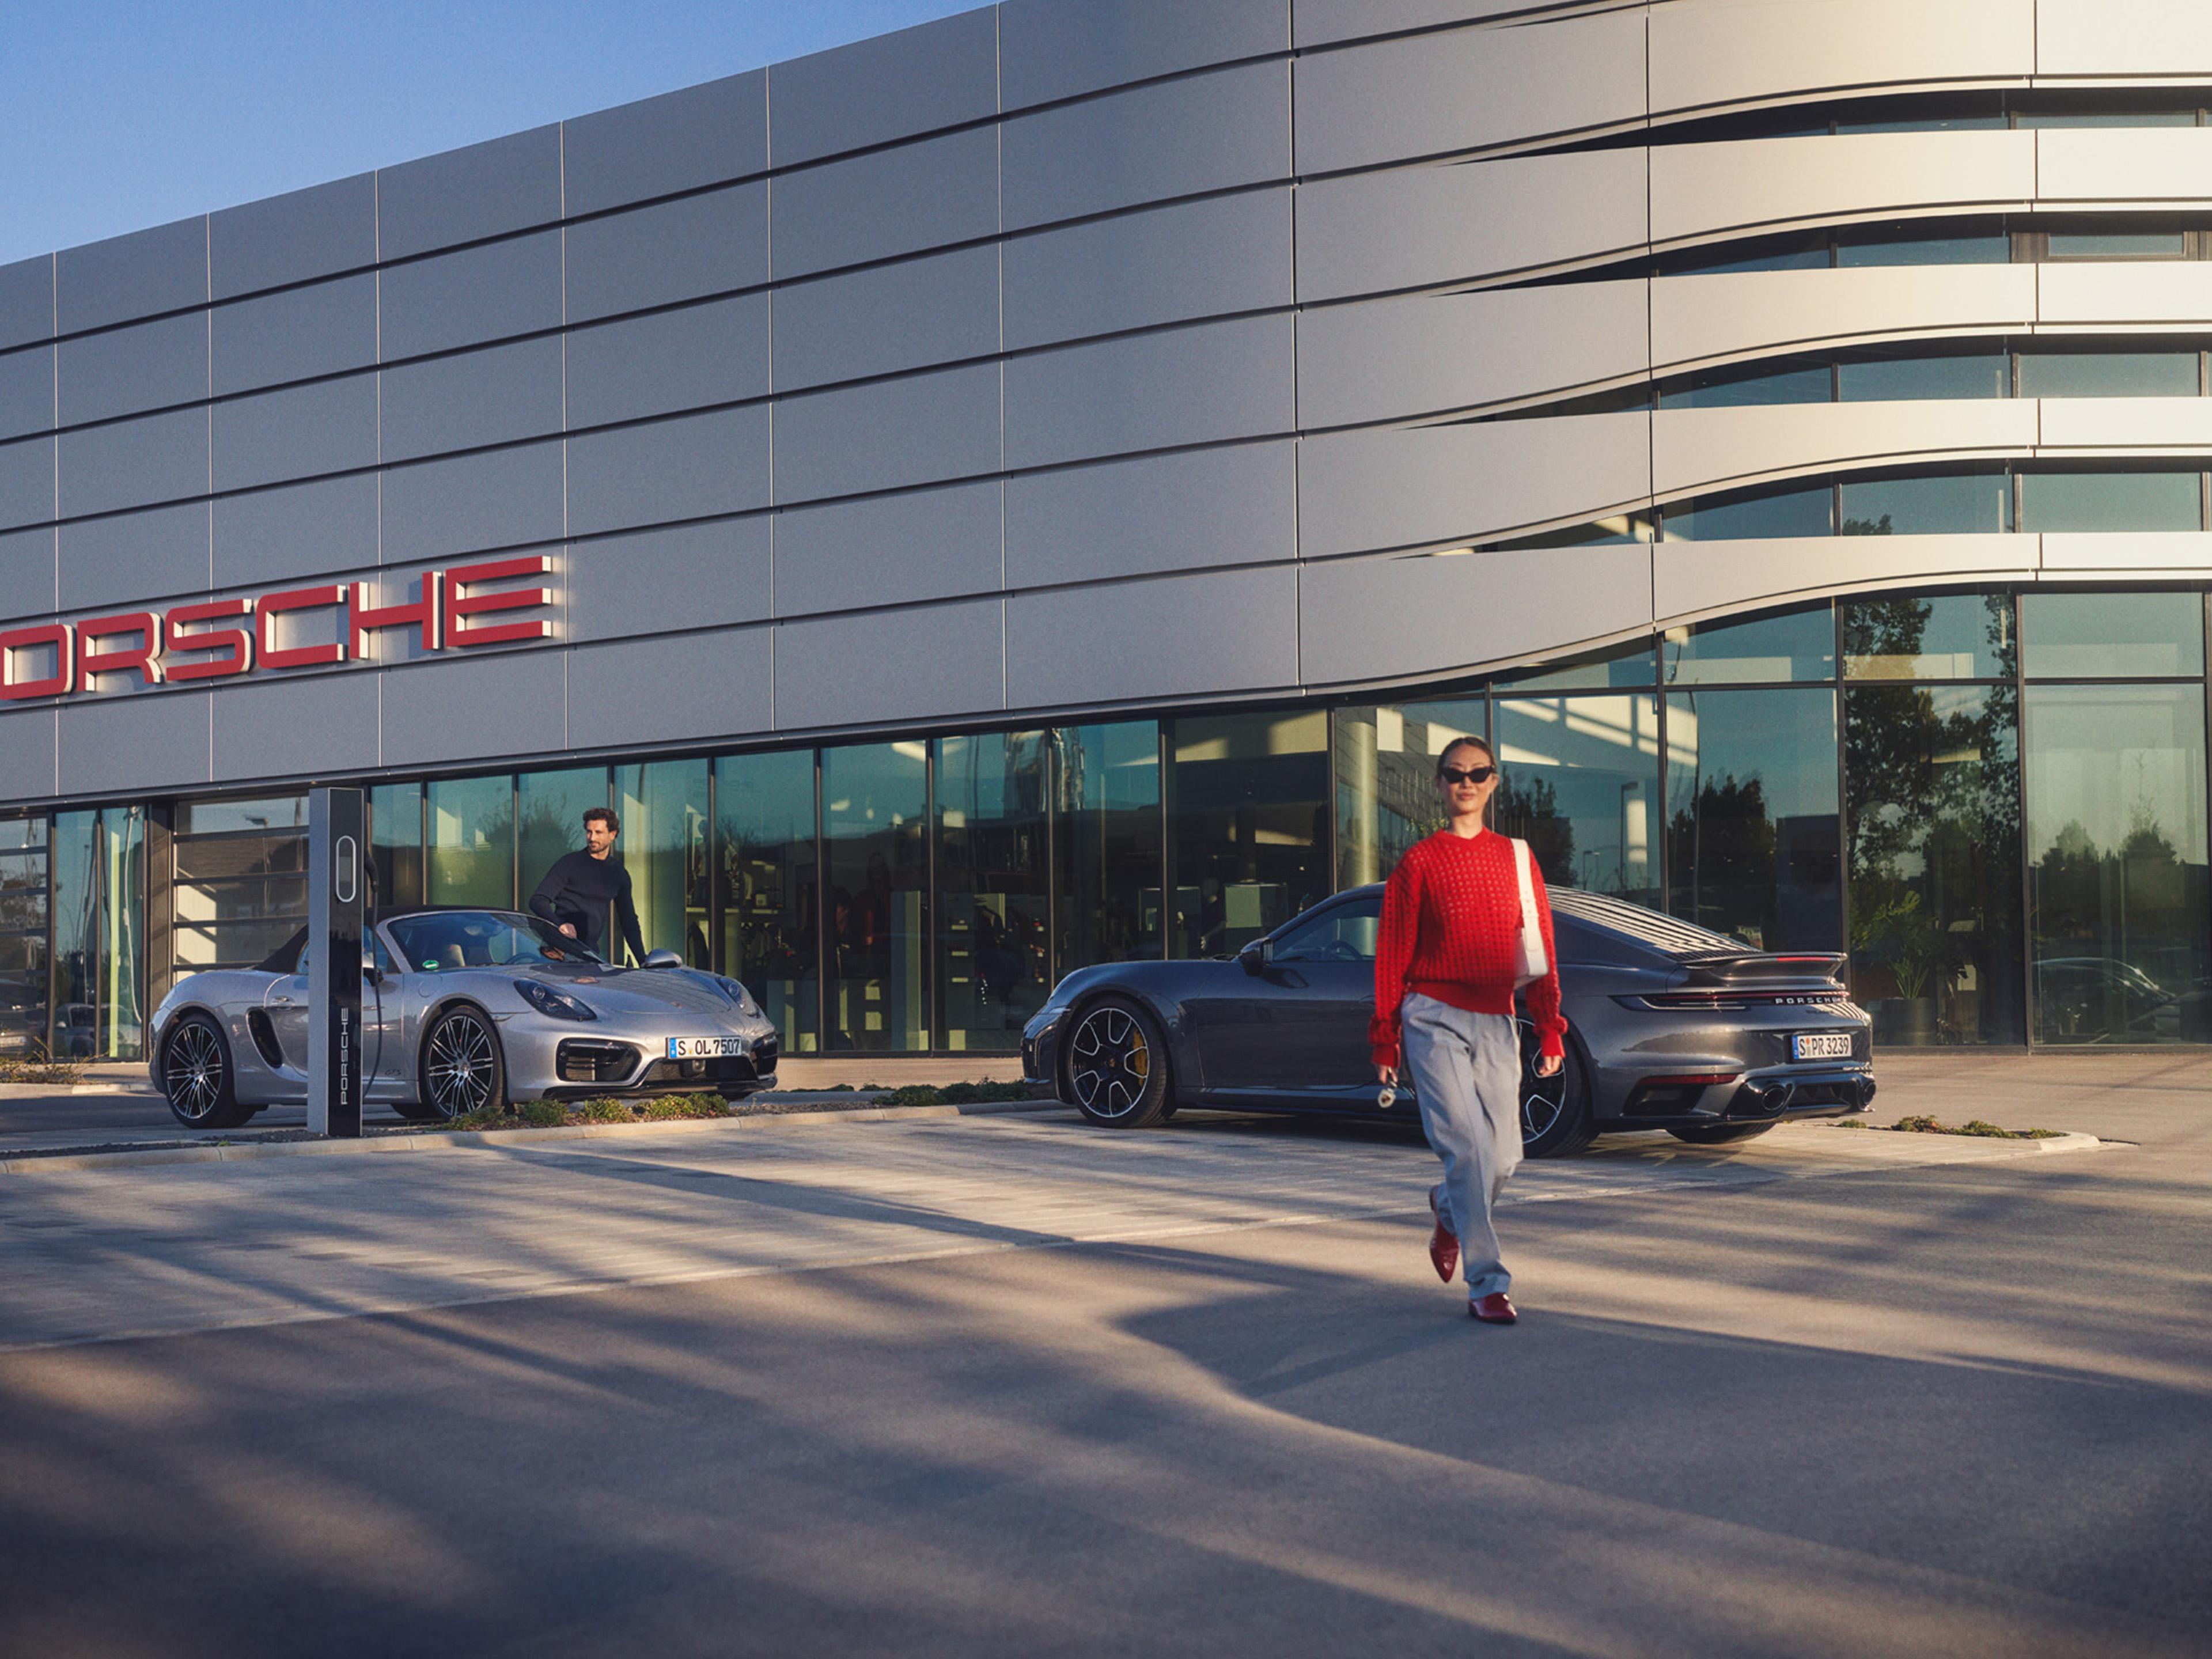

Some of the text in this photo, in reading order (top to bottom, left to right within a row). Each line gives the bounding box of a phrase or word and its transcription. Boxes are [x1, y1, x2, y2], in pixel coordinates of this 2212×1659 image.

[678, 1039, 740, 1055] S OL 7507
[1799, 1037, 1849, 1056] S PR 3239
